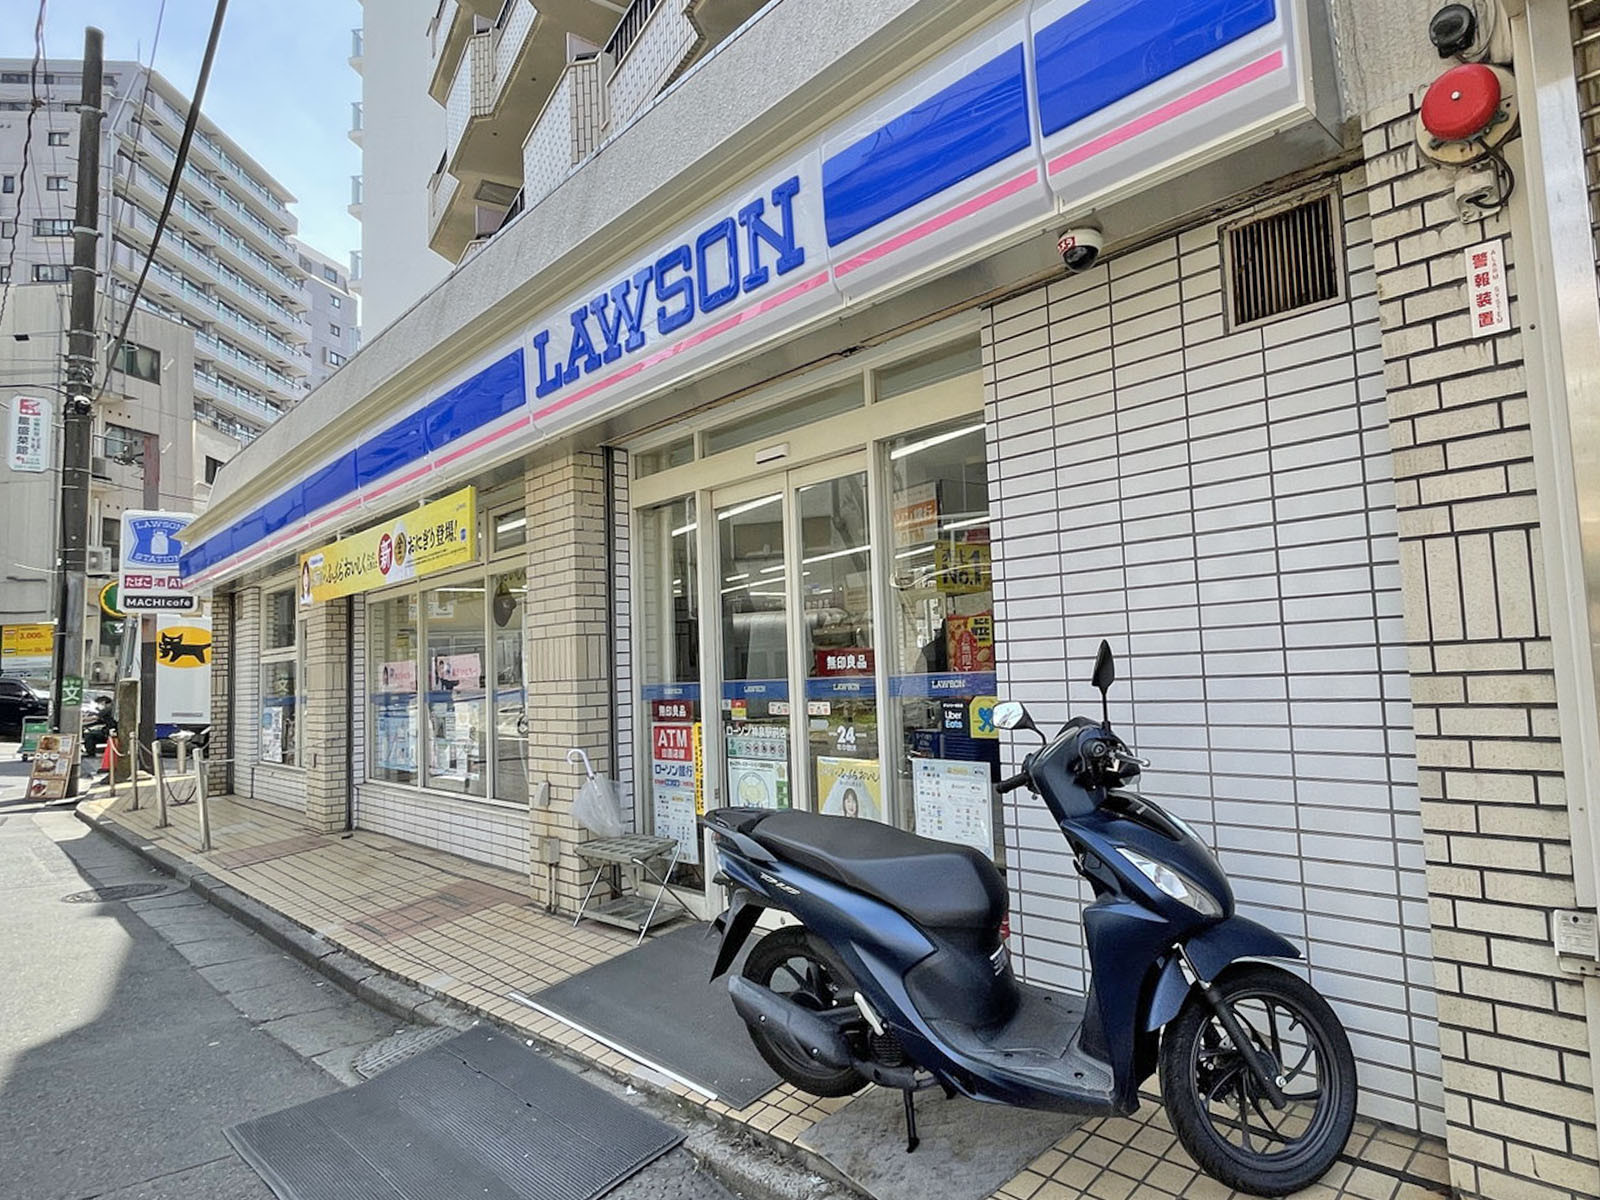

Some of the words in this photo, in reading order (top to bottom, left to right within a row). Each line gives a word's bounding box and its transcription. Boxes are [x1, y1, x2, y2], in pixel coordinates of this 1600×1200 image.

[533, 176, 804, 398] LAWSON
[1472, 252, 1494, 327] 警報装置
[125, 577, 151, 587] たばこ
[126, 598, 165, 606] MACHI
[827, 654, 867, 669] 無印良品
[63, 686, 80, 700] 文
[944, 711, 962, 720] Uber
[657, 729, 688, 747] ATM
[837, 726, 856, 743] 24
[655, 764, 693, 777] ローソン銀行
